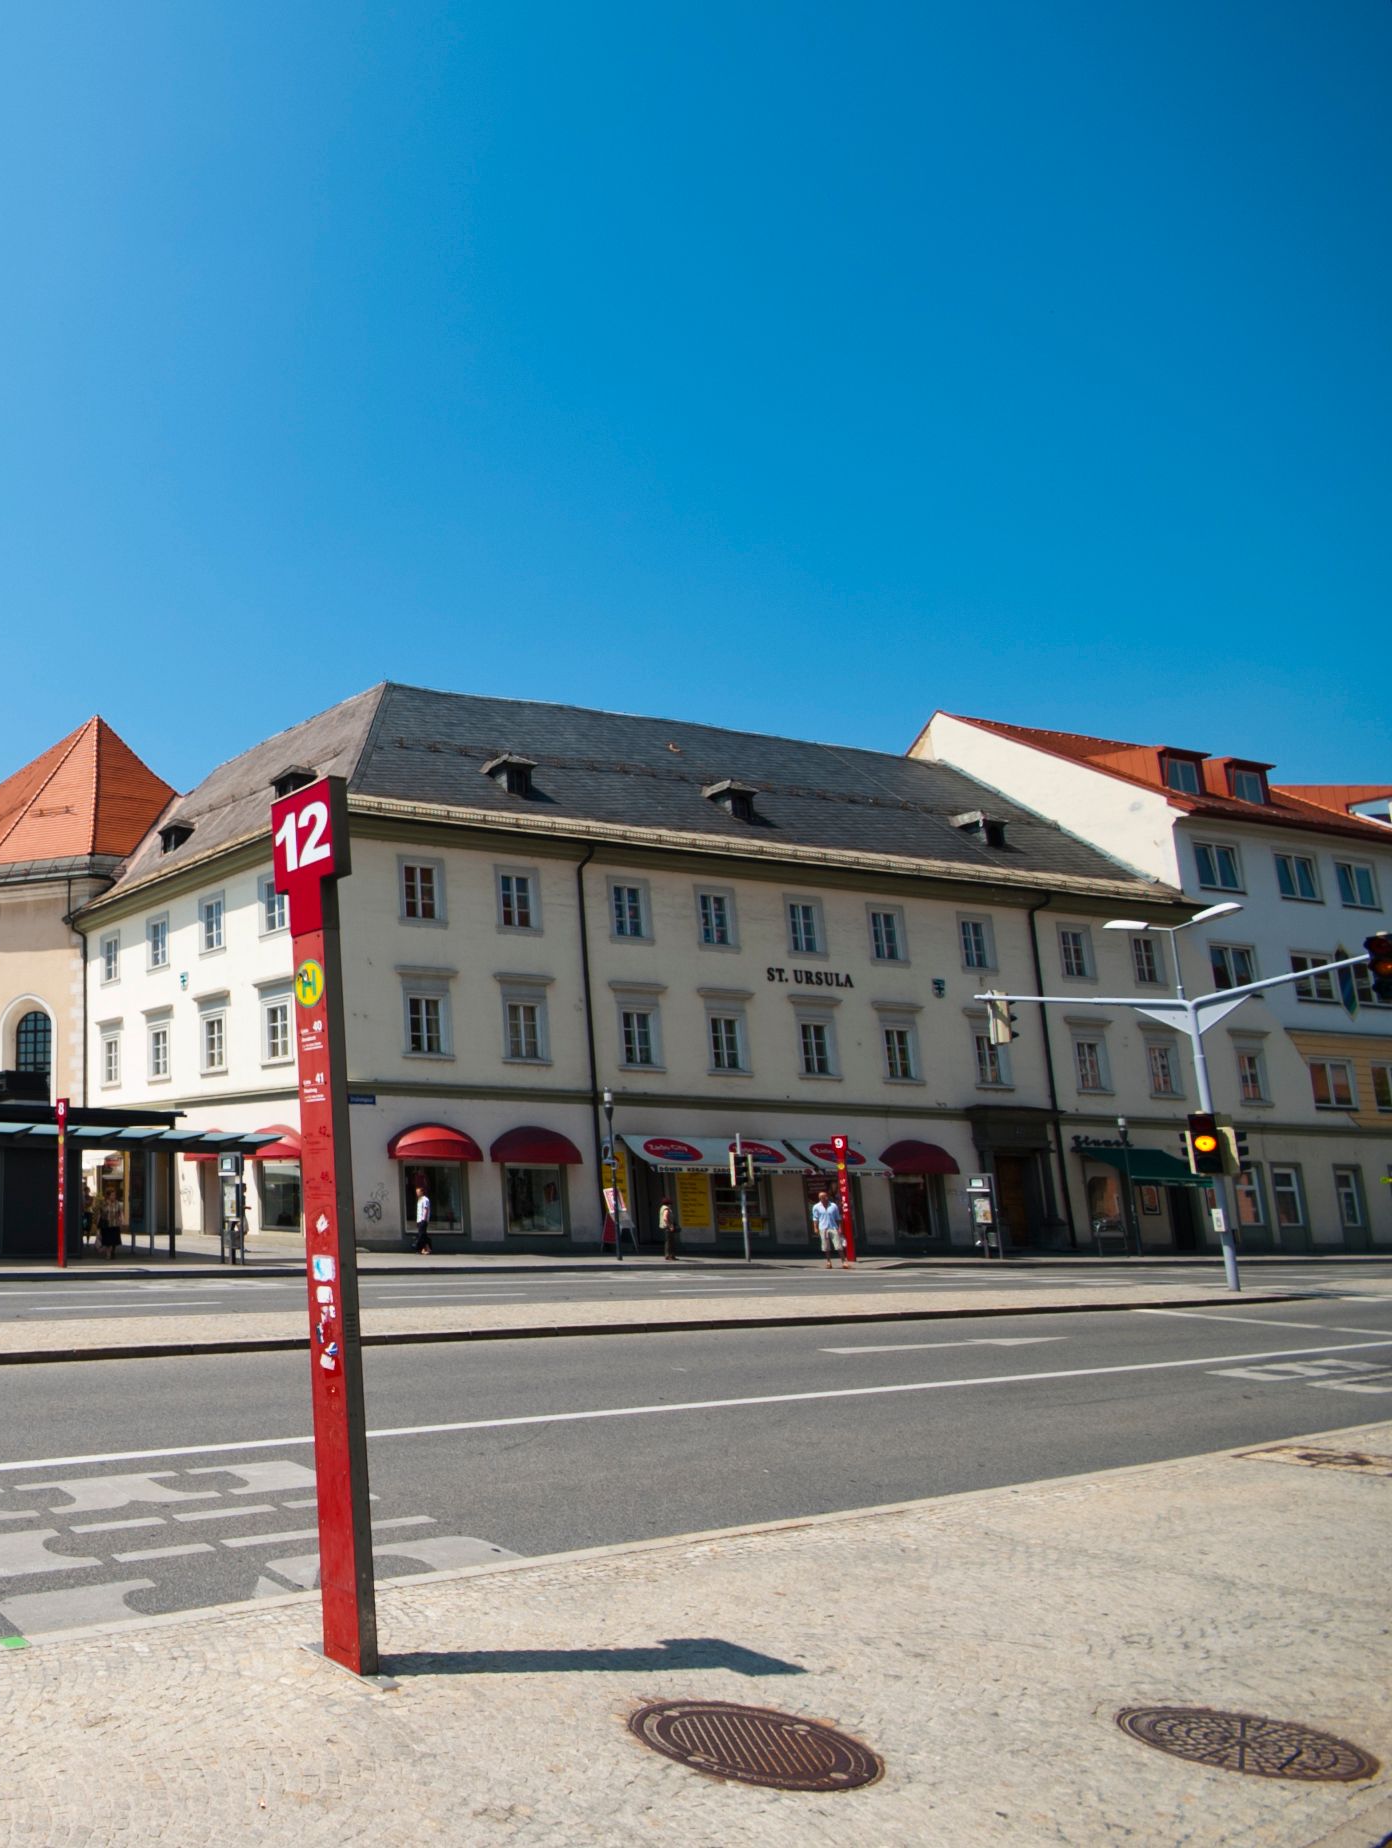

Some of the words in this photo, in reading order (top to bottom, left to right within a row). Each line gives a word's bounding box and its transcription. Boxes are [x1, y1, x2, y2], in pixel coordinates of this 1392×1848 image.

[275, 801, 331, 873] 12
[767, 967, 789, 983] ST.
[793, 969, 854, 988] URSULA
[312, 1020, 323, 1032] 40
[315, 1072, 325, 1084] 41
[58, 1102, 65, 1116] 8
[834, 1138, 844, 1149] 9
